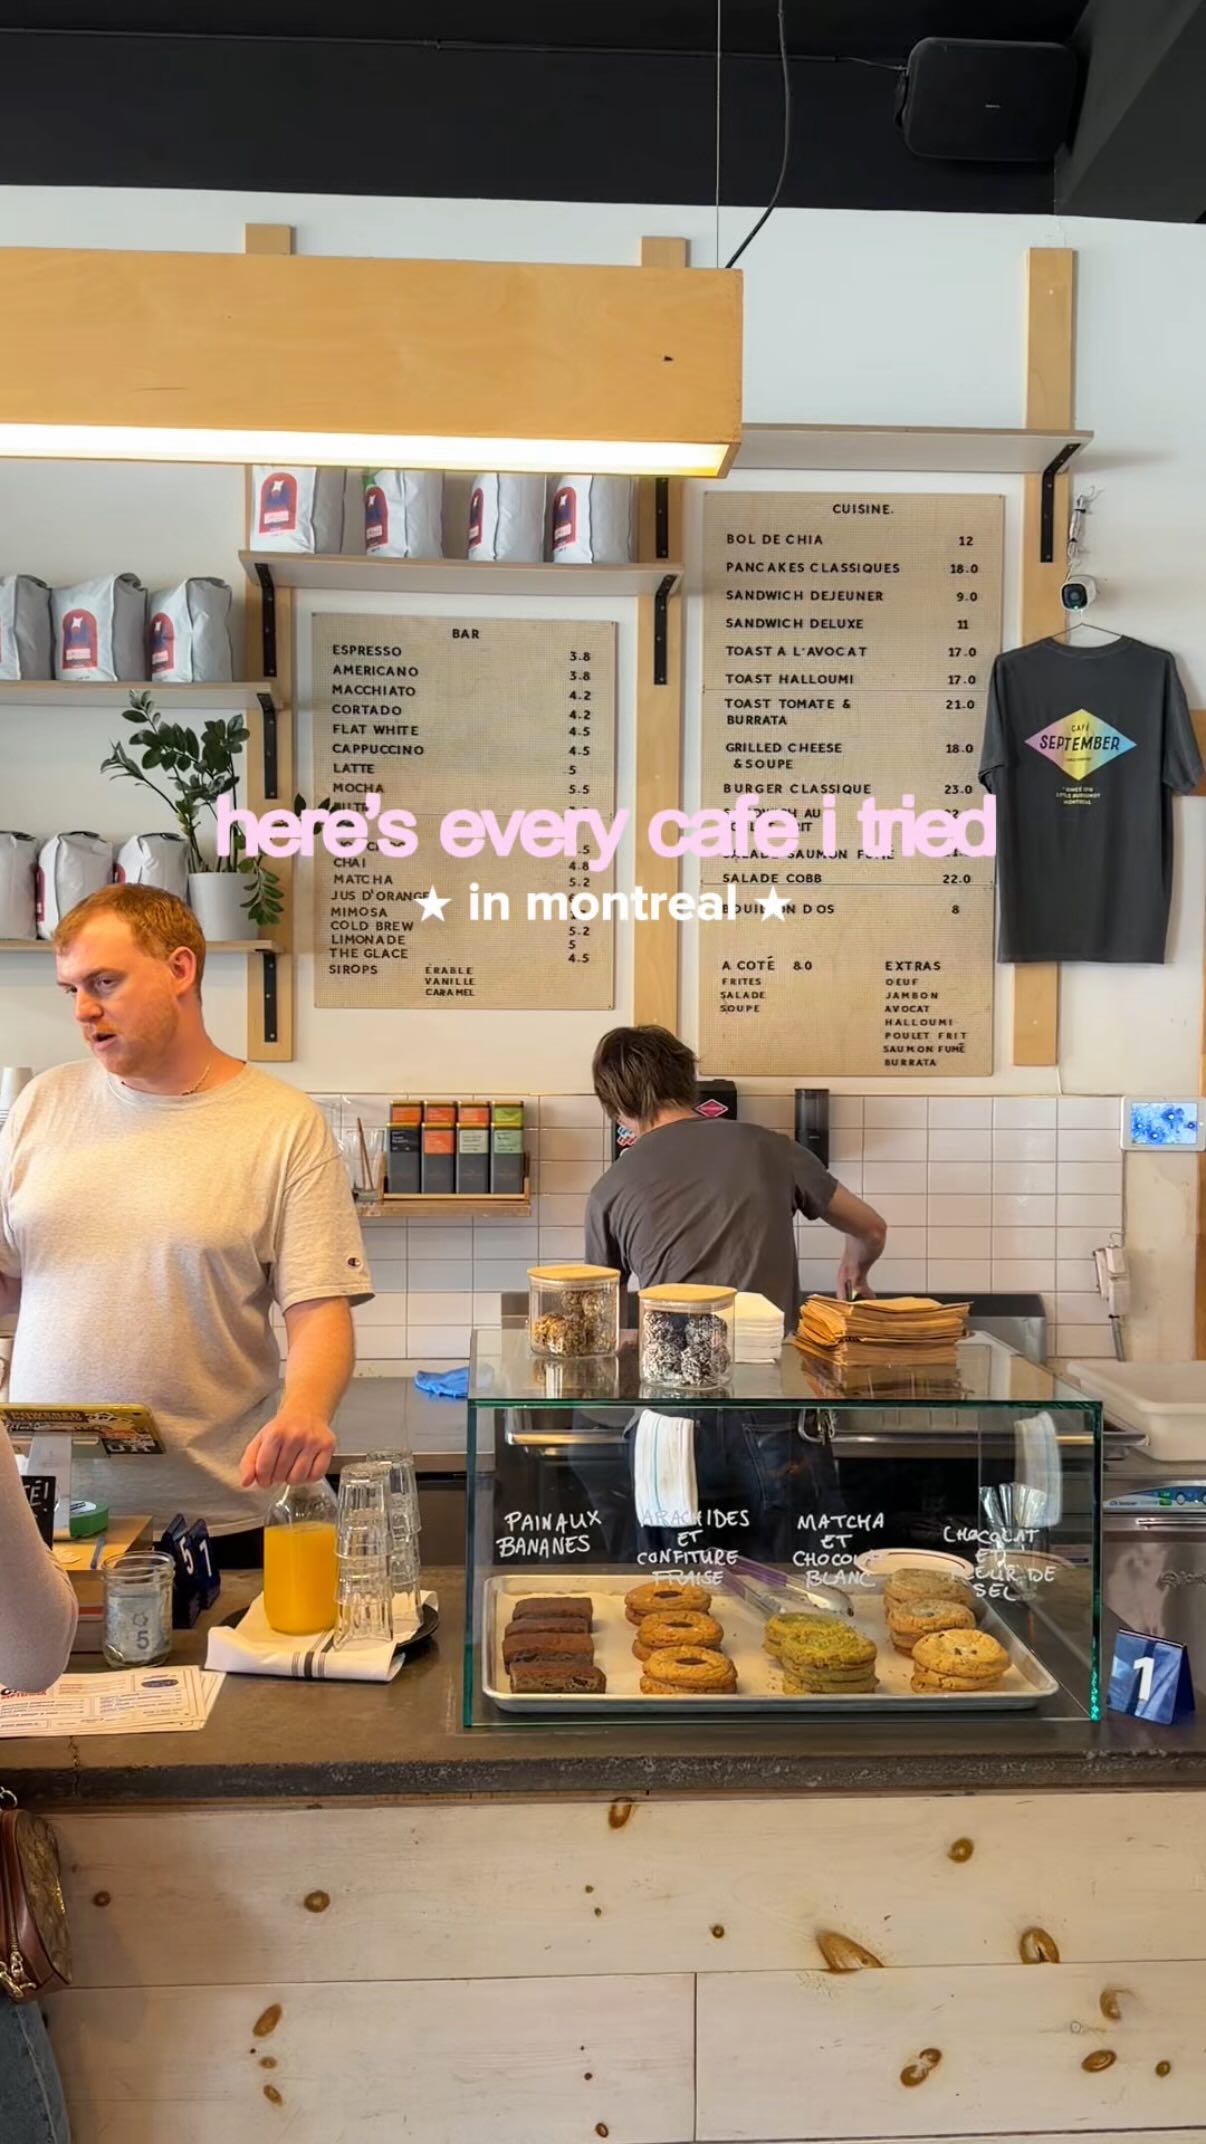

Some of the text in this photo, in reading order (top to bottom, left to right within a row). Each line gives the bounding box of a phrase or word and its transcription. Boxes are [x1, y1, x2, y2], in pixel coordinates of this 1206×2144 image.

[833, 503, 895, 515] CUISINE.
[726, 534, 824, 545] BOL DE CHIA
[958, 536, 974, 546] 12
[726, 562, 901, 574] PANCAKES CLASSIQUES
[950, 564, 978, 574] 18.0
[725, 590, 884, 602] SANDWICH DEJEUNER
[956, 592, 978, 602] 9.0
[725, 618, 864, 630] SANDWICH DELUXE
[957, 619, 969, 630] 11
[451, 628, 480, 640] BAR
[331, 644, 403, 657] ESPRESSO
[569, 650, 591, 662] 3.8
[725, 646, 773, 657] TOAST
[776, 646, 787, 657] A
[948, 647, 977, 657] 17.0
[332, 665, 419, 677] AMERICANO
[569, 670, 591, 681] 3.8
[725, 674, 855, 685] TOAST HALLOUMI
[948, 675, 977, 686] 17.0
[331, 684, 416, 697] MACCHIATO
[568, 690, 591, 701] 4.2
[331, 703, 402, 716] CORTADO
[724, 698, 851, 710] TOAST TOMATE &
[945, 700, 975, 710] 21.0
[568, 710, 591, 720] 4.2
[726, 715, 788, 726] BURRATA
[332, 724, 419, 736] FLAT WHITE
[568, 727, 591, 737] 4.5
[725, 742, 842, 754] GRILLED CHEESE
[1040, 735, 1121, 751] SEPTEMBER
[331, 743, 425, 756] CAPPUCCINO
[568, 745, 591, 756] 4.5
[945, 744, 974, 754] 18.0
[332, 763, 375, 775] LATTE
[568, 765, 577, 775] 5
[332, 783, 385, 794] MOCHA
[568, 784, 590, 795] 5.5
[723, 783, 872, 795] BURGER CLASSIQUE
[944, 785, 973, 795] 23.0
[804, 808, 822, 818] AU
[333, 857, 367, 869] CHAI
[568, 860, 590, 871] 4.8
[333, 874, 394, 885] MATCHA
[568, 877, 591, 888] 5.2
[722, 873, 823, 883] SALADE COBB
[942, 874, 971, 884] 22.0
[331, 890, 356, 901] JUS
[331, 907, 388, 917] MIMOSA
[951, 904, 960, 914] 8
[330, 921, 414, 931] COLD BREW
[568, 926, 590, 936] 5.2
[331, 934, 405, 945] LIMONADE
[568, 940, 576, 949] 5
[329, 948, 408, 959] THE GLACE
[568, 953, 589, 963] 4.5
[721, 960, 731, 970] A
[736, 956, 776, 970] COTÉ
[885, 960, 941, 971] EXTRAS
[328, 964, 378, 975] SIROPS
[424, 977, 475, 986] VANILLE
[721, 977, 762, 986] FRITES
[885, 978, 919, 986] OEUF
[425, 988, 475, 997] CARAMEL
[720, 991, 766, 999] SALADE
[885, 991, 939, 1000] JAMBON
[720, 1004, 761, 1012] SOUPE
[884, 1005, 931, 1013] AVOCAT
[884, 1018, 954, 1026] HALLOUMI
[884, 1032, 968, 1040] POULET FRIT
[883, 1045, 934, 1053] SAUMON
[884, 1058, 937, 1067] BURRATA
[797, 1512, 885, 1532] MATCHA
[677, 1530, 704, 1548] ET
[820, 1534, 854, 1550] ET
[495, 1534, 592, 1559] BANANES
[636, 1549, 740, 1567] CONFITURE
[651, 1570, 725, 1587] FRAISE
[804, 1569, 877, 1589] BLANC
[1027, 1567, 1057, 1582] DE
[973, 1583, 1017, 1601] SEL
[136, 1630, 150, 1649] 5
[1133, 1656, 1156, 1702] 1
